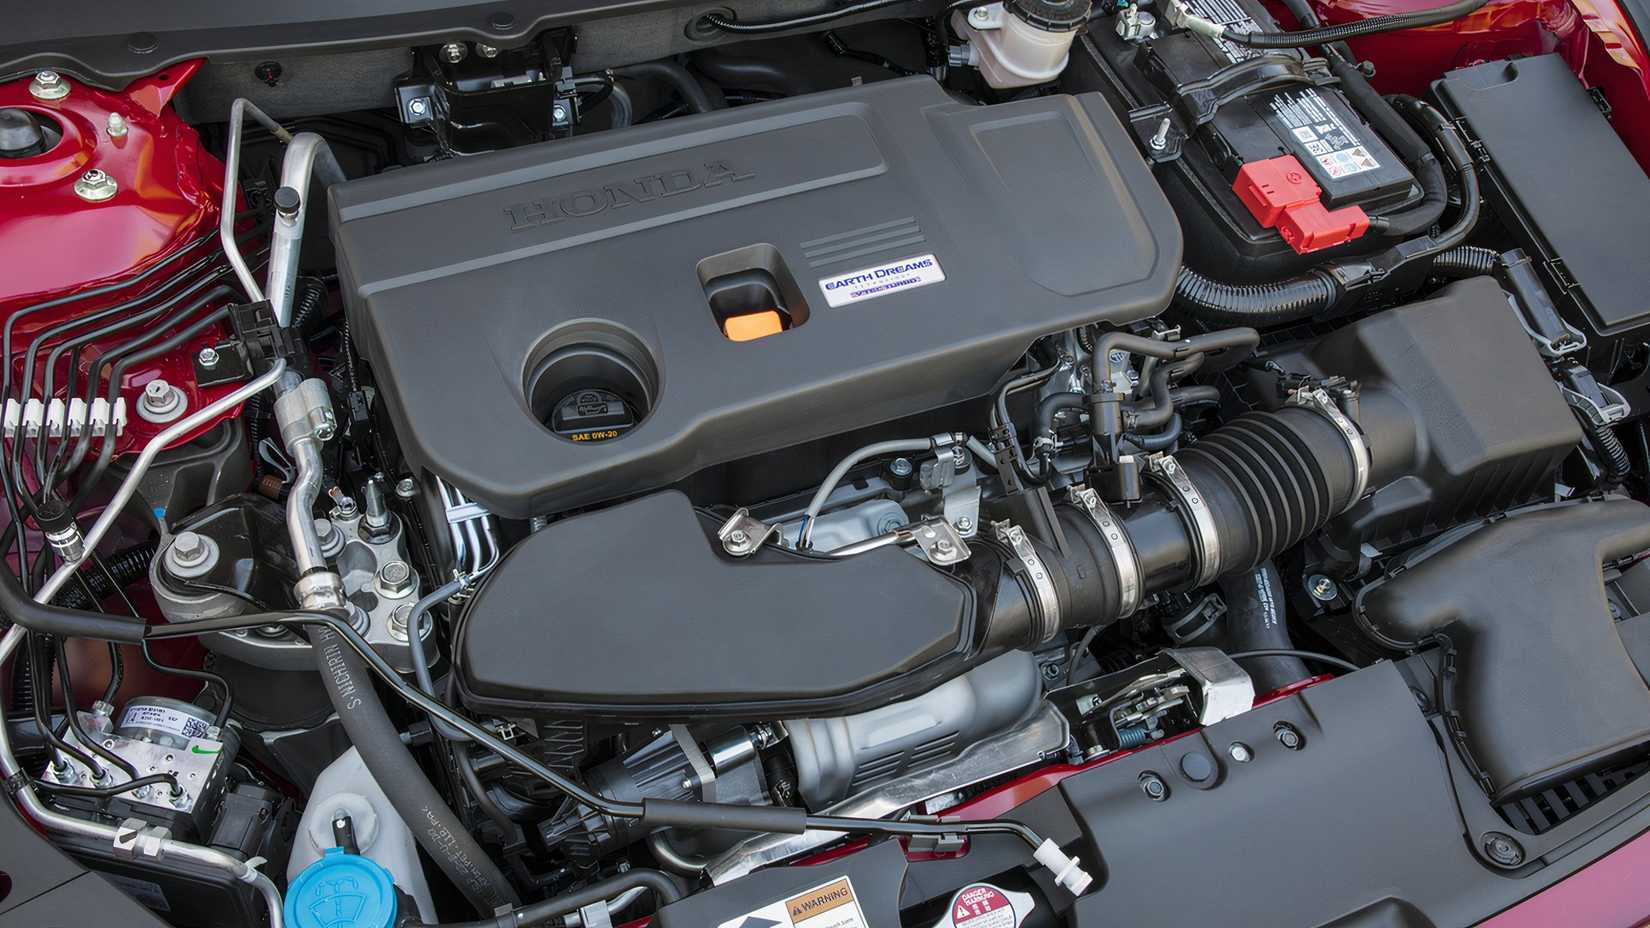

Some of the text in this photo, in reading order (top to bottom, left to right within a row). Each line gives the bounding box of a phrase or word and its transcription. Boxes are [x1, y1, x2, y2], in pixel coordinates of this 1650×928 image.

[504, 160, 756, 230] HONDA
[825, 258, 933, 291] EARTH DREAMS
[572, 433, 591, 441] SAE
[801, 887, 849, 912] WARNING
